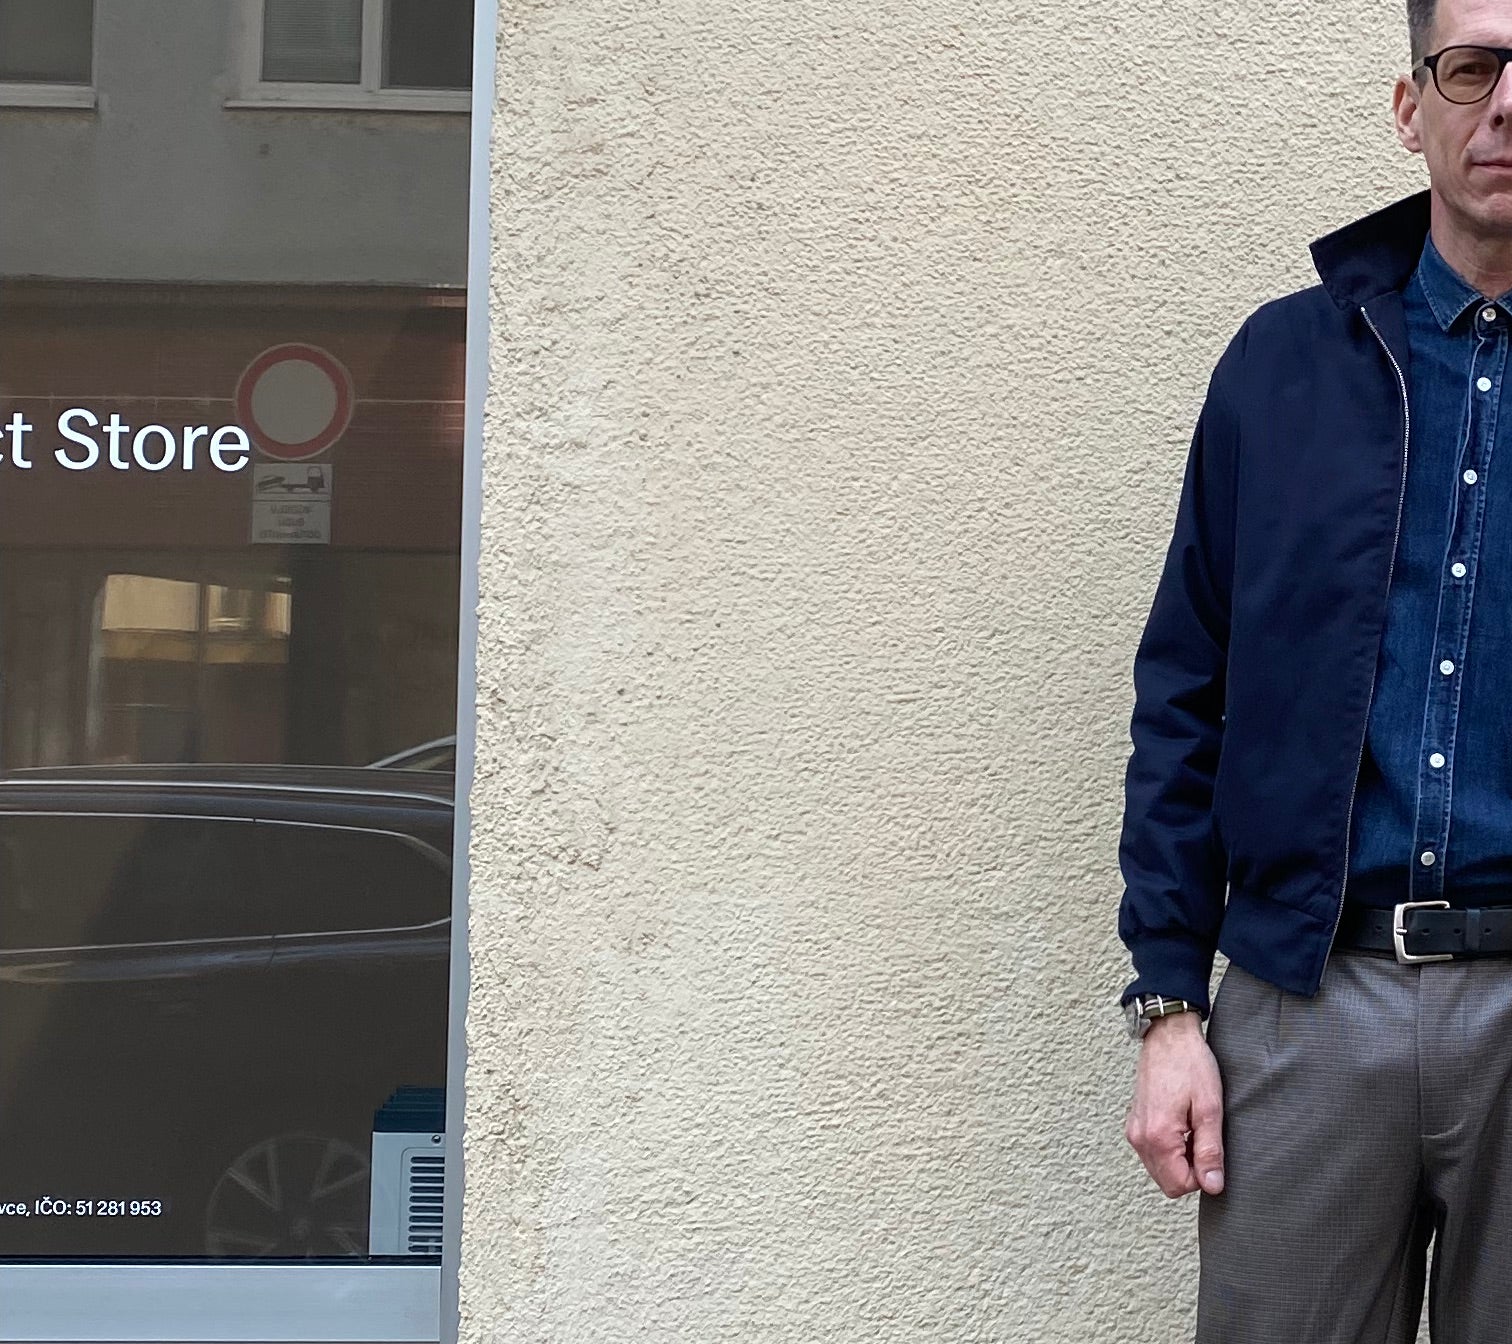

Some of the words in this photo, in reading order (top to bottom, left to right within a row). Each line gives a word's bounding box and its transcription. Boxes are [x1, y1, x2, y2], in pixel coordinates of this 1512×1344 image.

[0, 412, 33, 469] t
[54, 408, 250, 472] Store
[34, 1196, 72, 1216] IČO:
[129, 1200, 162, 1216] 953
